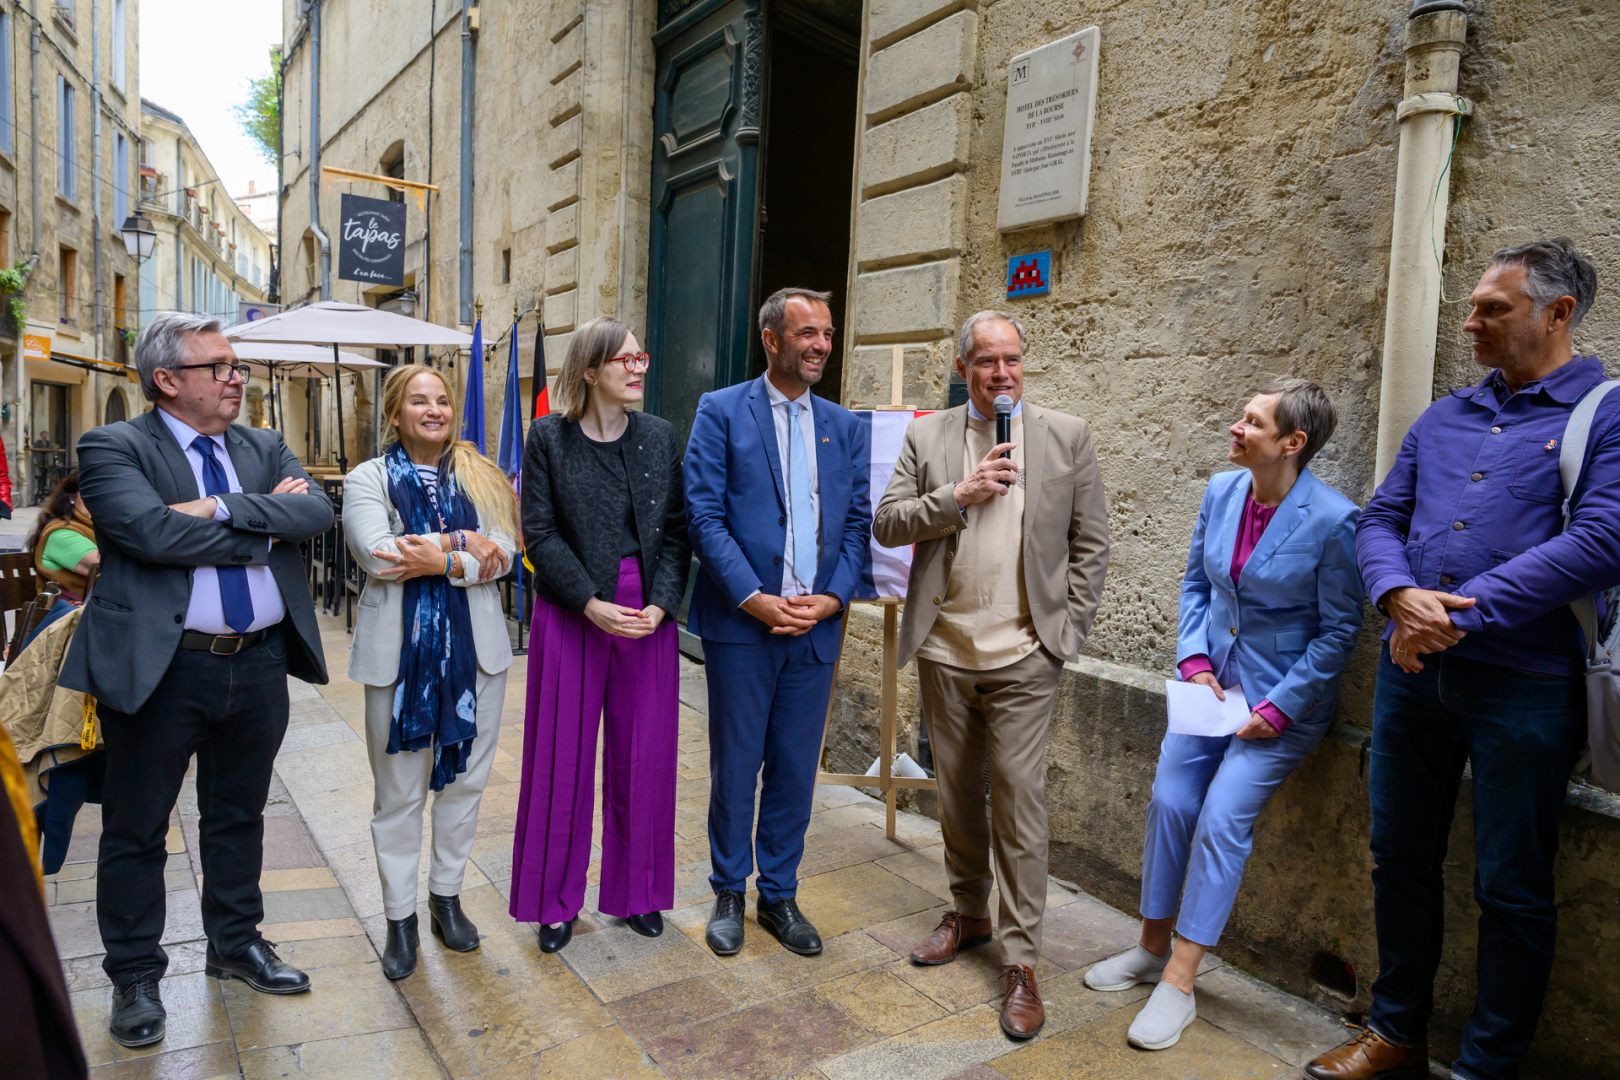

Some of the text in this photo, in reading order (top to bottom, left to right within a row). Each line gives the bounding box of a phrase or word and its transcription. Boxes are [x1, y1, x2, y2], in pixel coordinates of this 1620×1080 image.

[1014, 65, 1026, 81] M
[1034, 99, 1044, 108] DES
[1043, 102, 1064, 114] BOURSE
[369, 217, 379, 229] le
[344, 218, 401, 253] tapas
